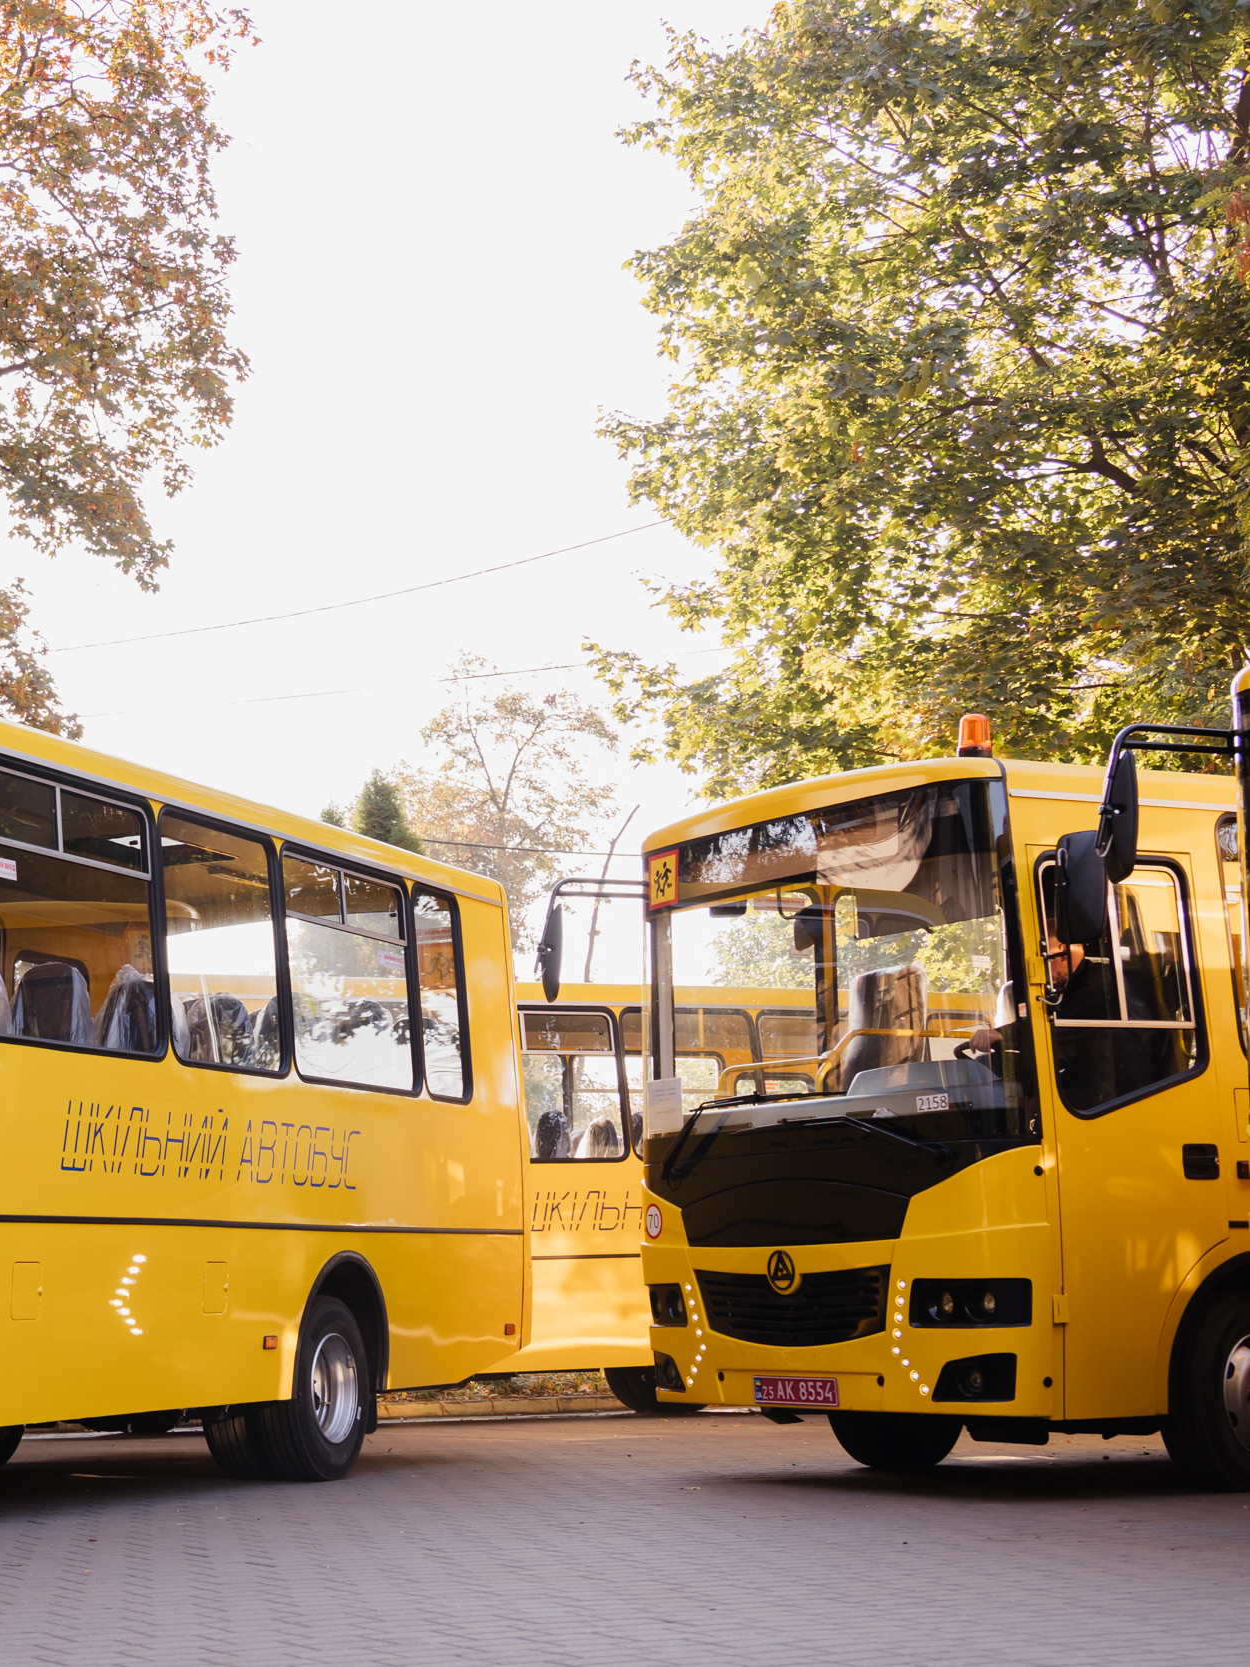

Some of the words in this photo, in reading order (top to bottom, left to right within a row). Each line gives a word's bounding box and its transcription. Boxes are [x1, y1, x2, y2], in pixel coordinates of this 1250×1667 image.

[918, 1095, 948, 1110] 2158
[60, 1100, 229, 1181] ШКІЛЬНИЙ
[236, 1119, 361, 1190] АВТОБУС
[648, 1213, 660, 1229] 70
[755, 1391, 763, 1399] UA
[762, 1385, 774, 1400] 25
[799, 1381, 833, 1402] 8554
